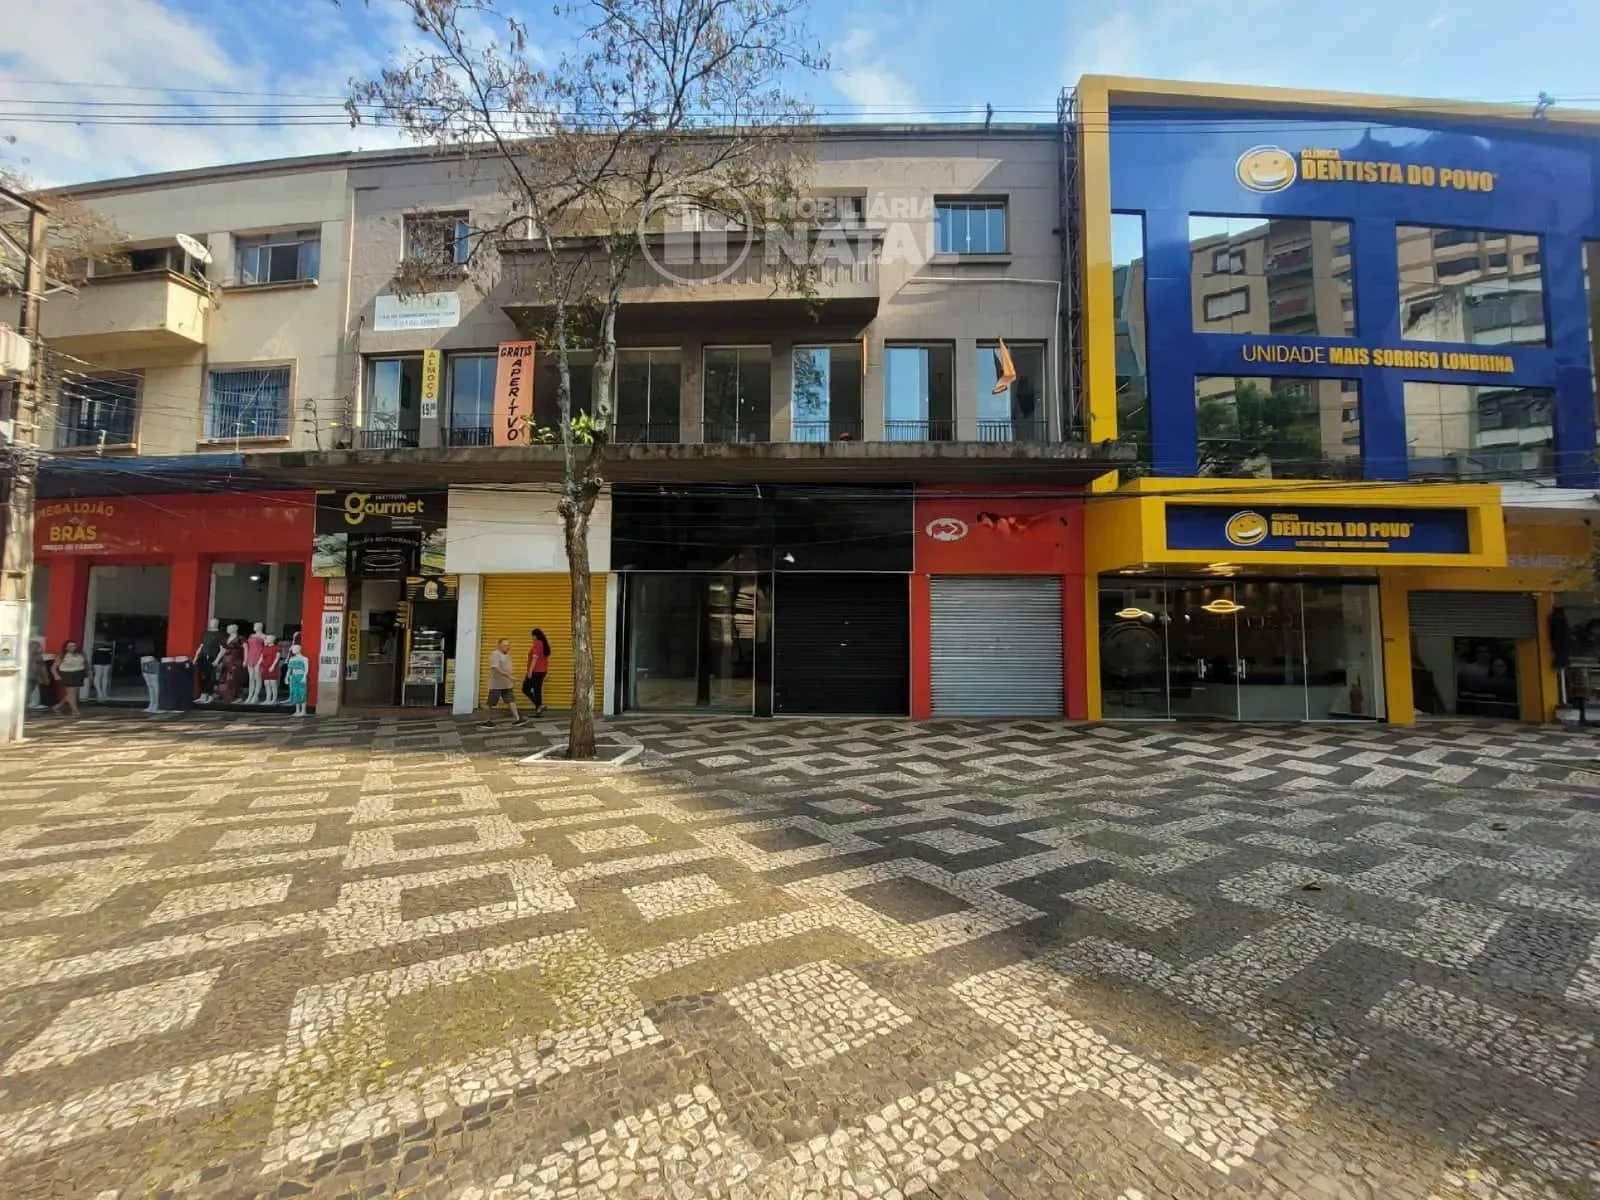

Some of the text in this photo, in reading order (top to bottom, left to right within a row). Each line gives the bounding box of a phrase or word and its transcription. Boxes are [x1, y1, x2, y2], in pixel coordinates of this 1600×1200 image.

[1301, 159, 1494, 192] DENTISTA DO POVO
[1242, 344, 1514, 373] UNIDADE MAIS SORRISO LONDRINA
[36, 501, 114, 519] MEGA LOJÃO
[344, 492, 424, 524] gourmet
[1271, 521, 1411, 538] DENTISTA DO POVO
